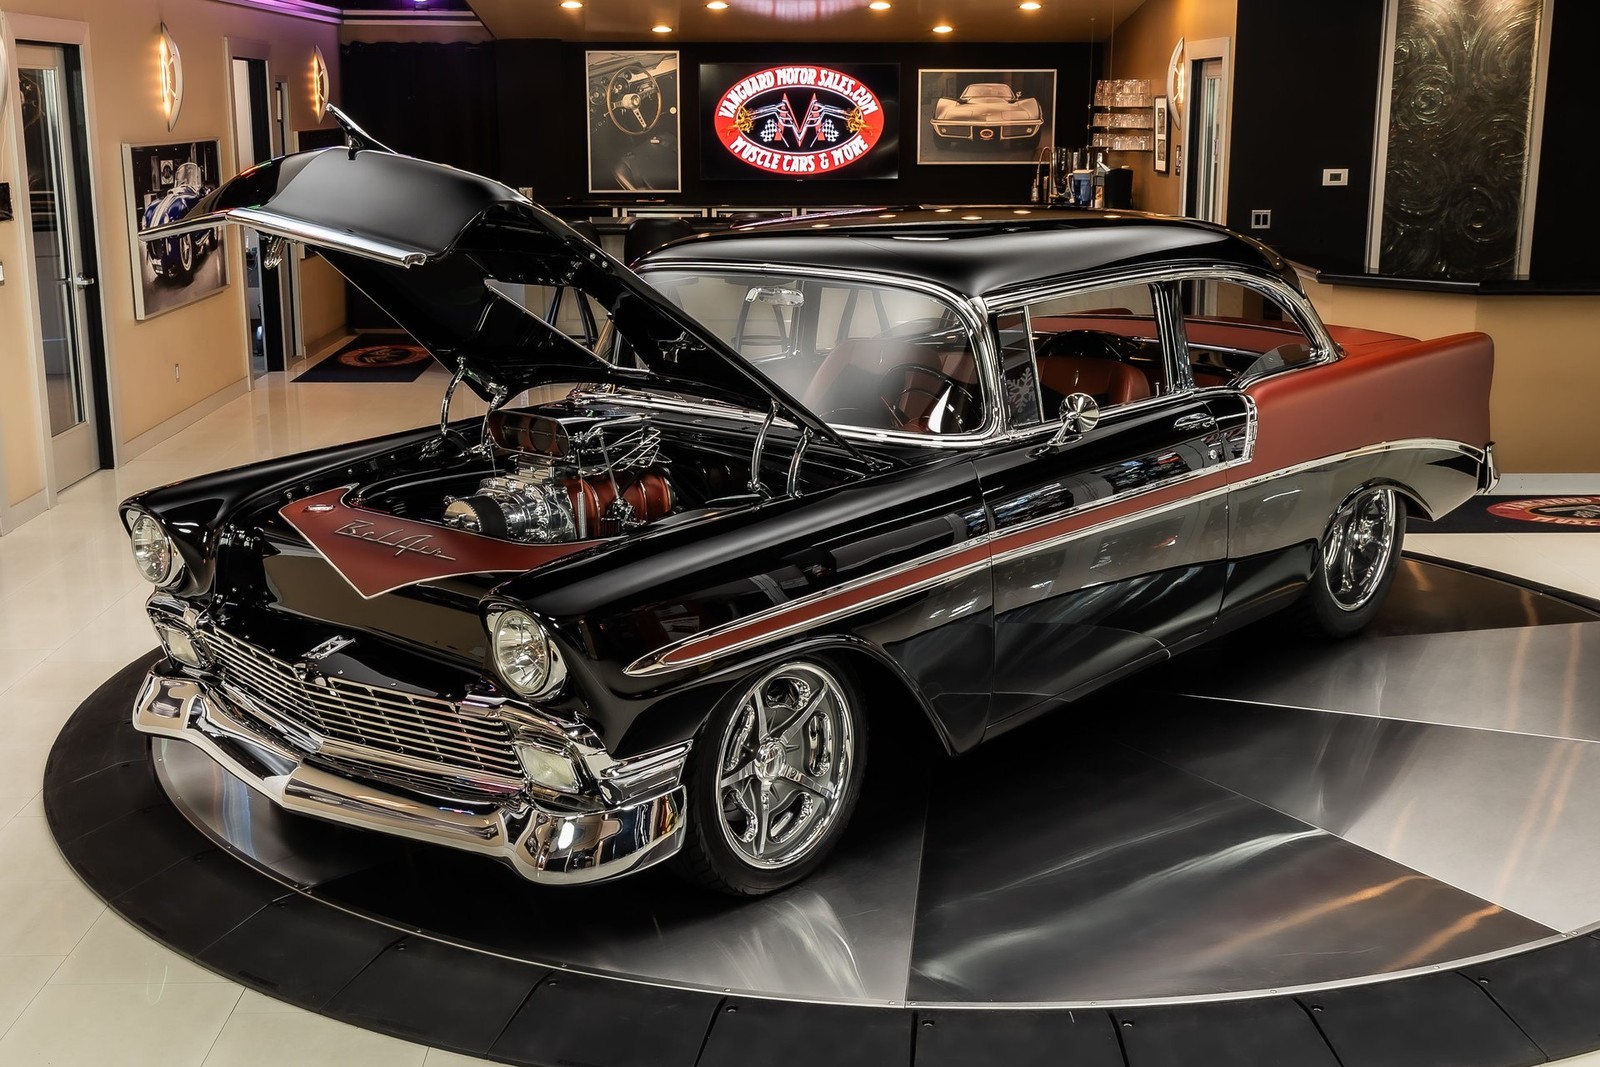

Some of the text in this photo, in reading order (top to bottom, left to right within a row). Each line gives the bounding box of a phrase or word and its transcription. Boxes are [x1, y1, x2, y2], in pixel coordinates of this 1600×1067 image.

[718, 68, 879, 118] VANGUARD MOTOR SALES.COM
[729, 134, 869, 172] MUSCLE CARS & MORE
[334, 519, 456, 560] Bel Air
